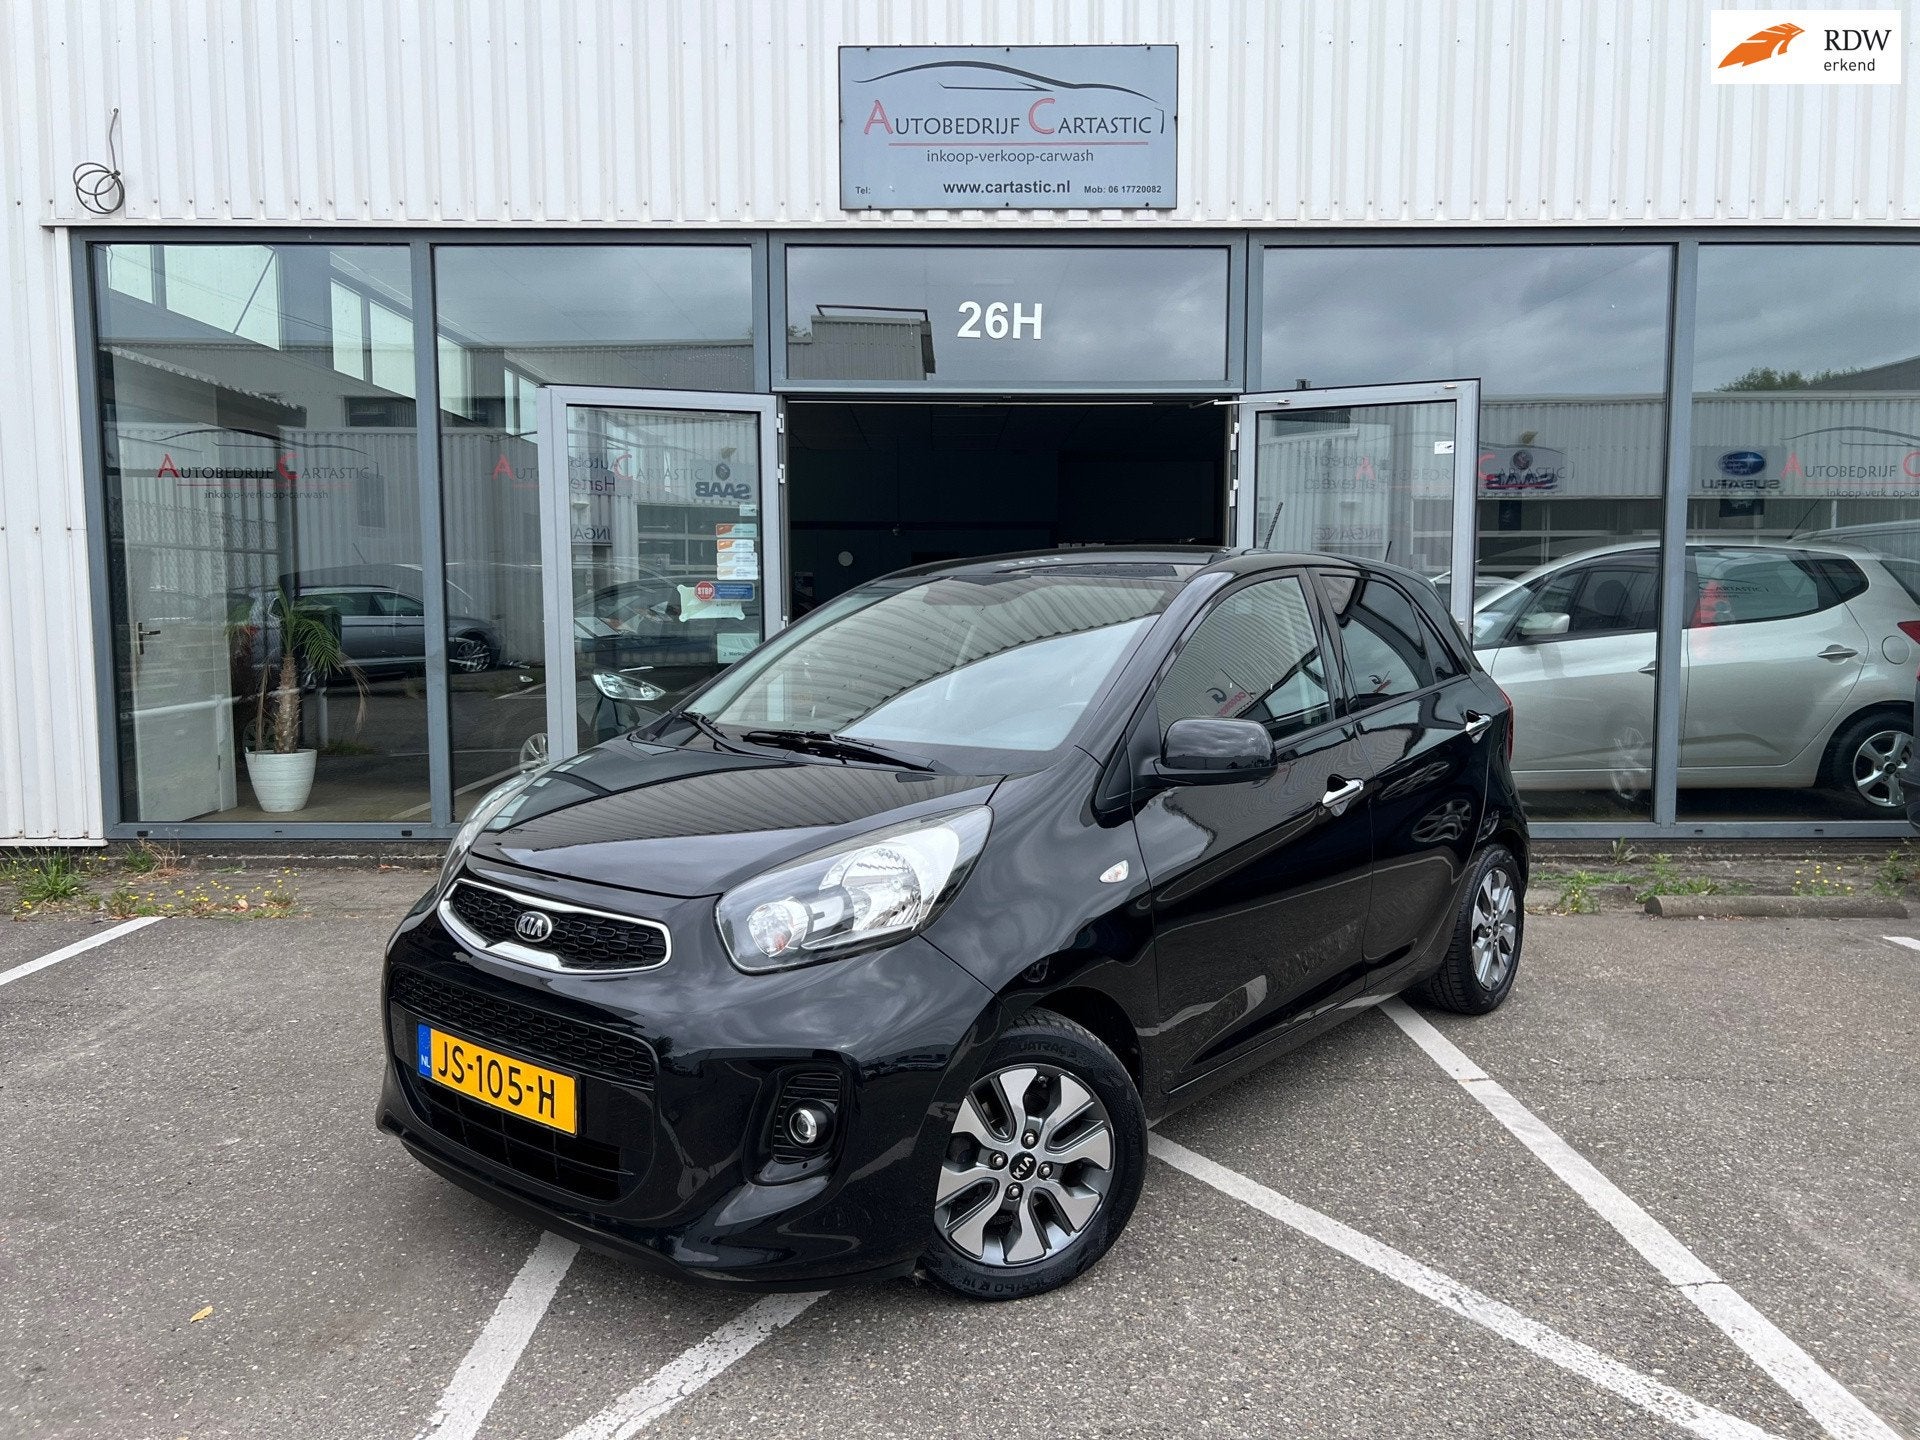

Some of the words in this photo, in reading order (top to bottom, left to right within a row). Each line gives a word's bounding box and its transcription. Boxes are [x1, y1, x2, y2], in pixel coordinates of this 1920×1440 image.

[864, 100, 1020, 135] AUTOBEDRIJF
[1028, 98, 1152, 135] CARTASTIC
[926, 149, 1094, 165] inkoop-verkoop-carwash
[855, 186, 871, 195] Tel:
[943, 180, 1071, 194] www.cartastic.nl
[1084, 185, 1106, 194] Mob:
[1108, 185, 1119, 194] 06
[1121, 185, 1162, 194] 17720082
[957, 300, 1043, 340] 26H
[1780, 451, 1898, 479] AUTOBEDRIJF
[697, 587, 713, 595] STOP
[517, 915, 544, 938] KIA
[420, 1055, 431, 1069] NL
[438, 1041, 556, 1119] JS-105-H
[1012, 1156, 1034, 1178] KIA
